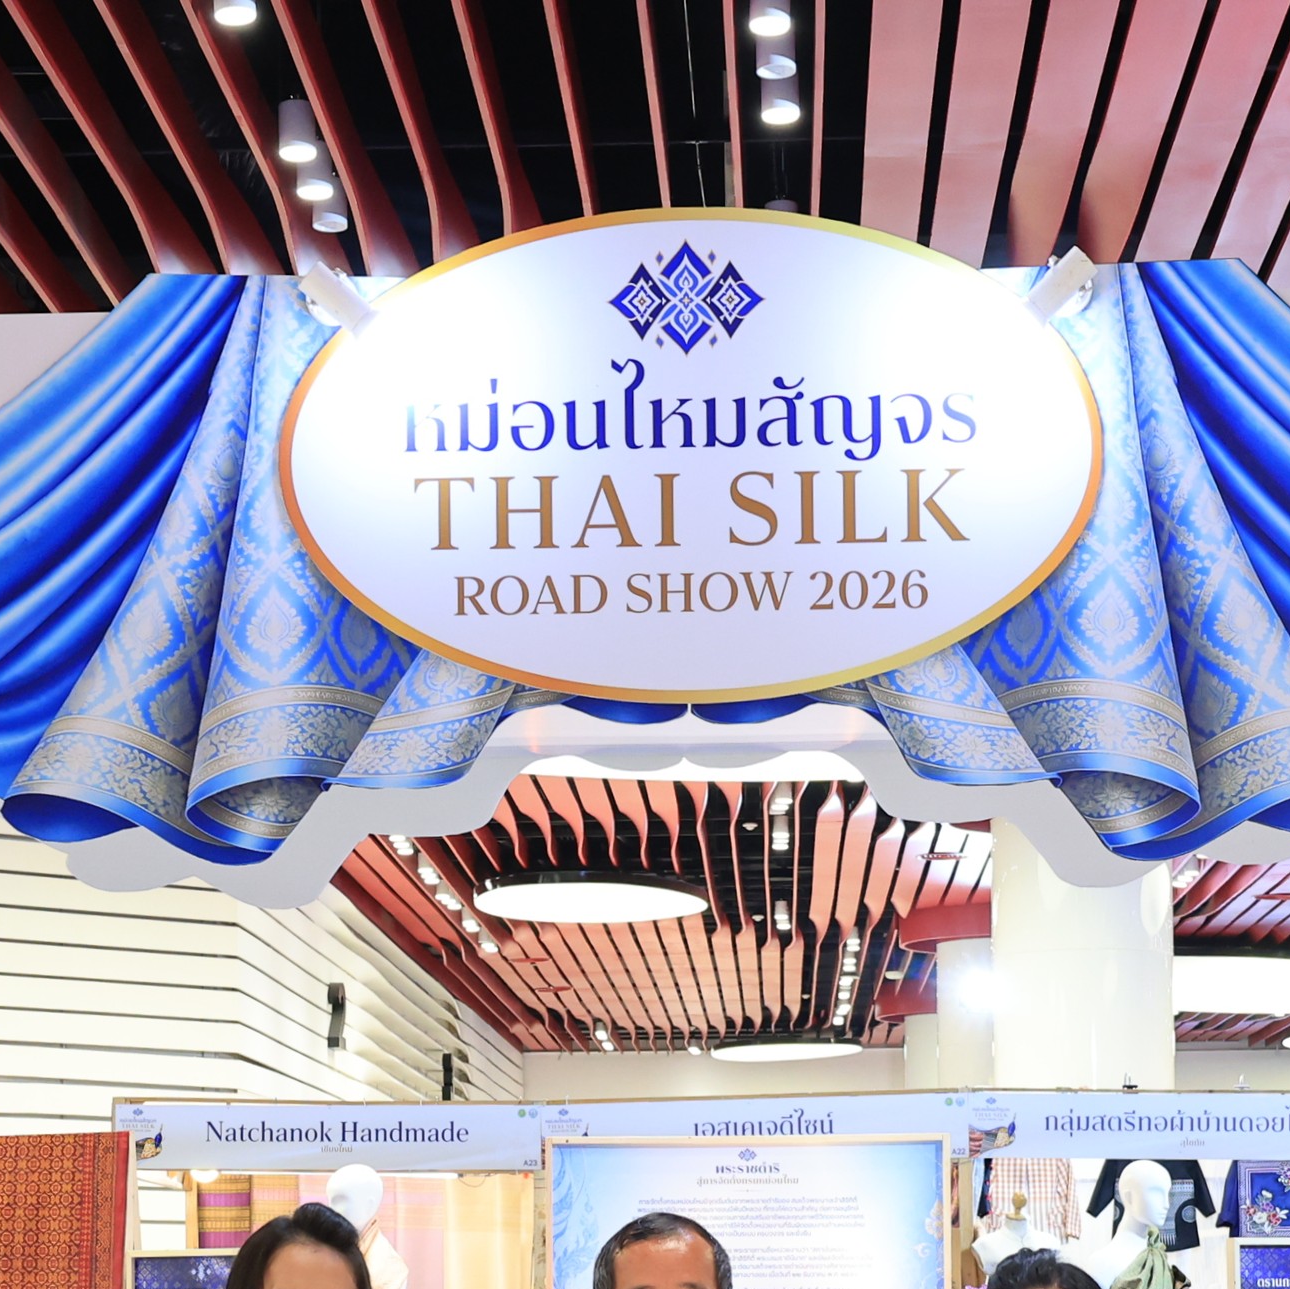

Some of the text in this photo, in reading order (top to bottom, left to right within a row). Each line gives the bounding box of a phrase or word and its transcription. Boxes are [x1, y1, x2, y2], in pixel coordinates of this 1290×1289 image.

[403, 358, 978, 461] หม่อนไหมสัญจร
[413, 467, 971, 551] THAI SILK
[454, 568, 930, 617] ROAD SHOW 2026
[206, 1120, 469, 1143] Natchanok Handmade
[693, 1107, 834, 1136] เอสเคเจดีไซน์
[320, 1143, 353, 1153] เชียงใหม่
[951, 1147, 966, 1156] A22
[715, 1161, 781, 1174] พระราชดำริ
